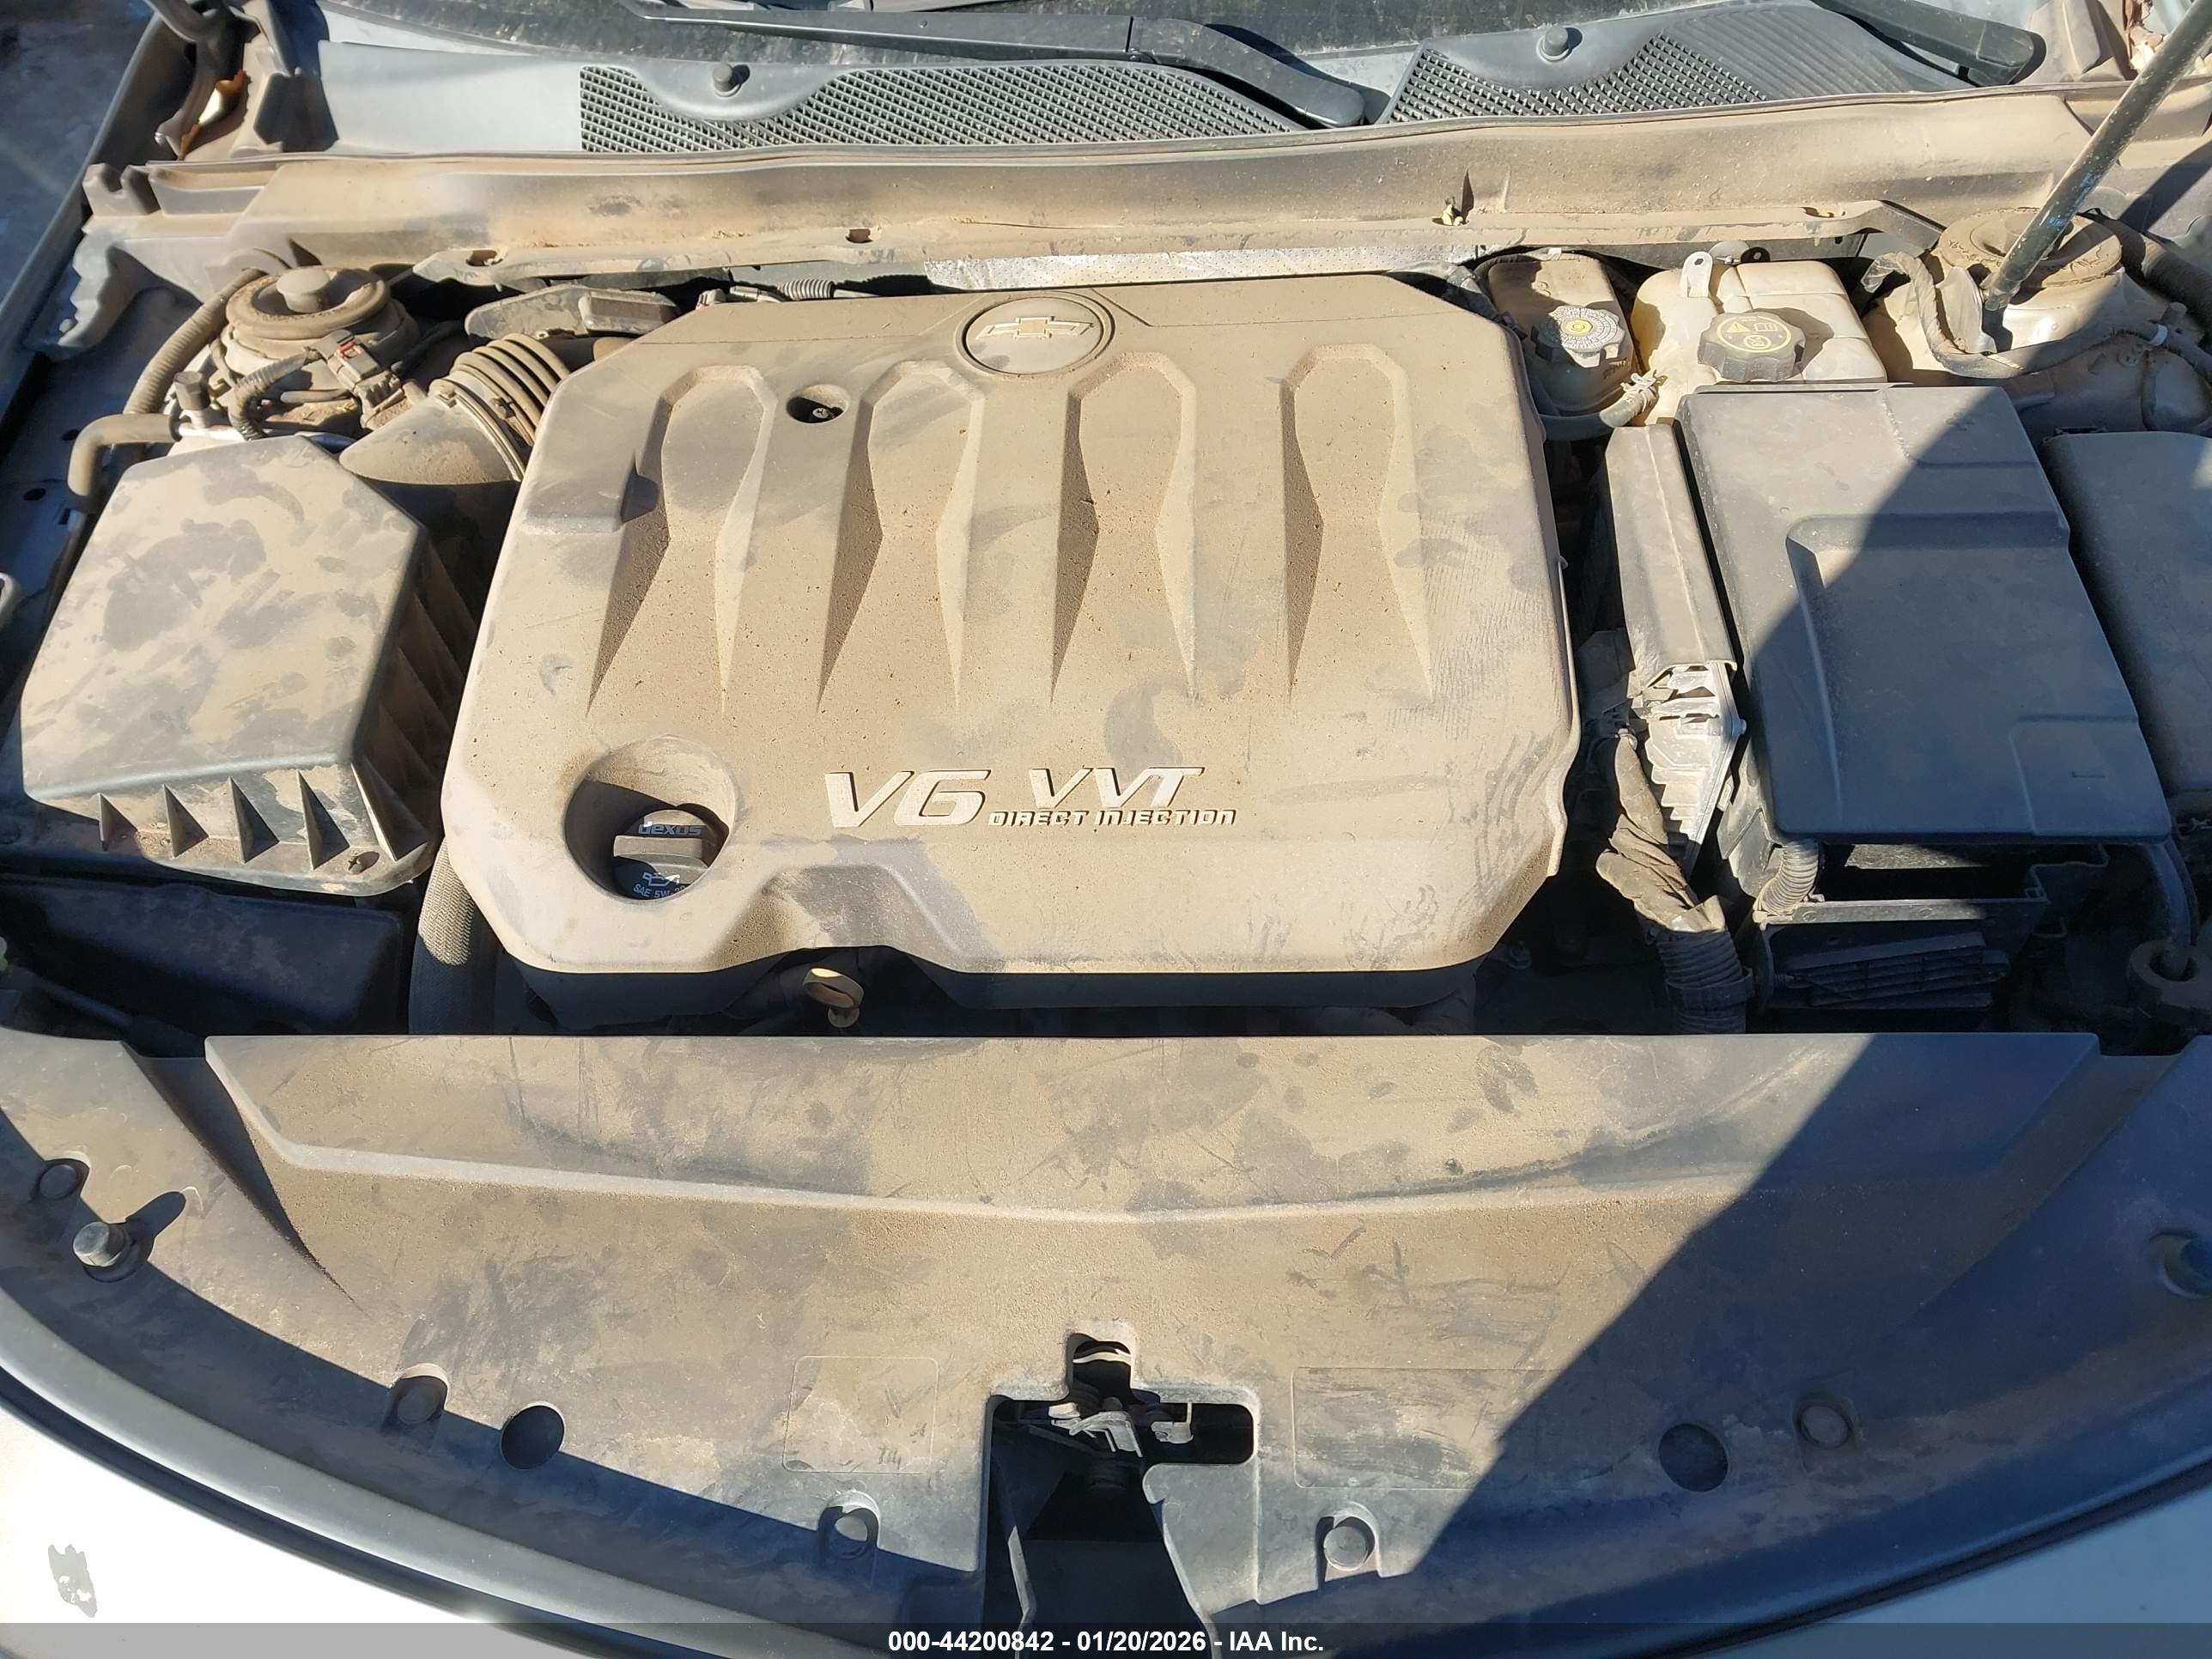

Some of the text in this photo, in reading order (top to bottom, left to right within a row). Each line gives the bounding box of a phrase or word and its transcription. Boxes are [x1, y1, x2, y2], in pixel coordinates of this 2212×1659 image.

[824, 766, 1205, 828] V6 VVT
[988, 809, 1237, 827] DIRECT INJECTION
[638, 823, 703, 836] dexos
[633, 884, 652, 897] SAE
